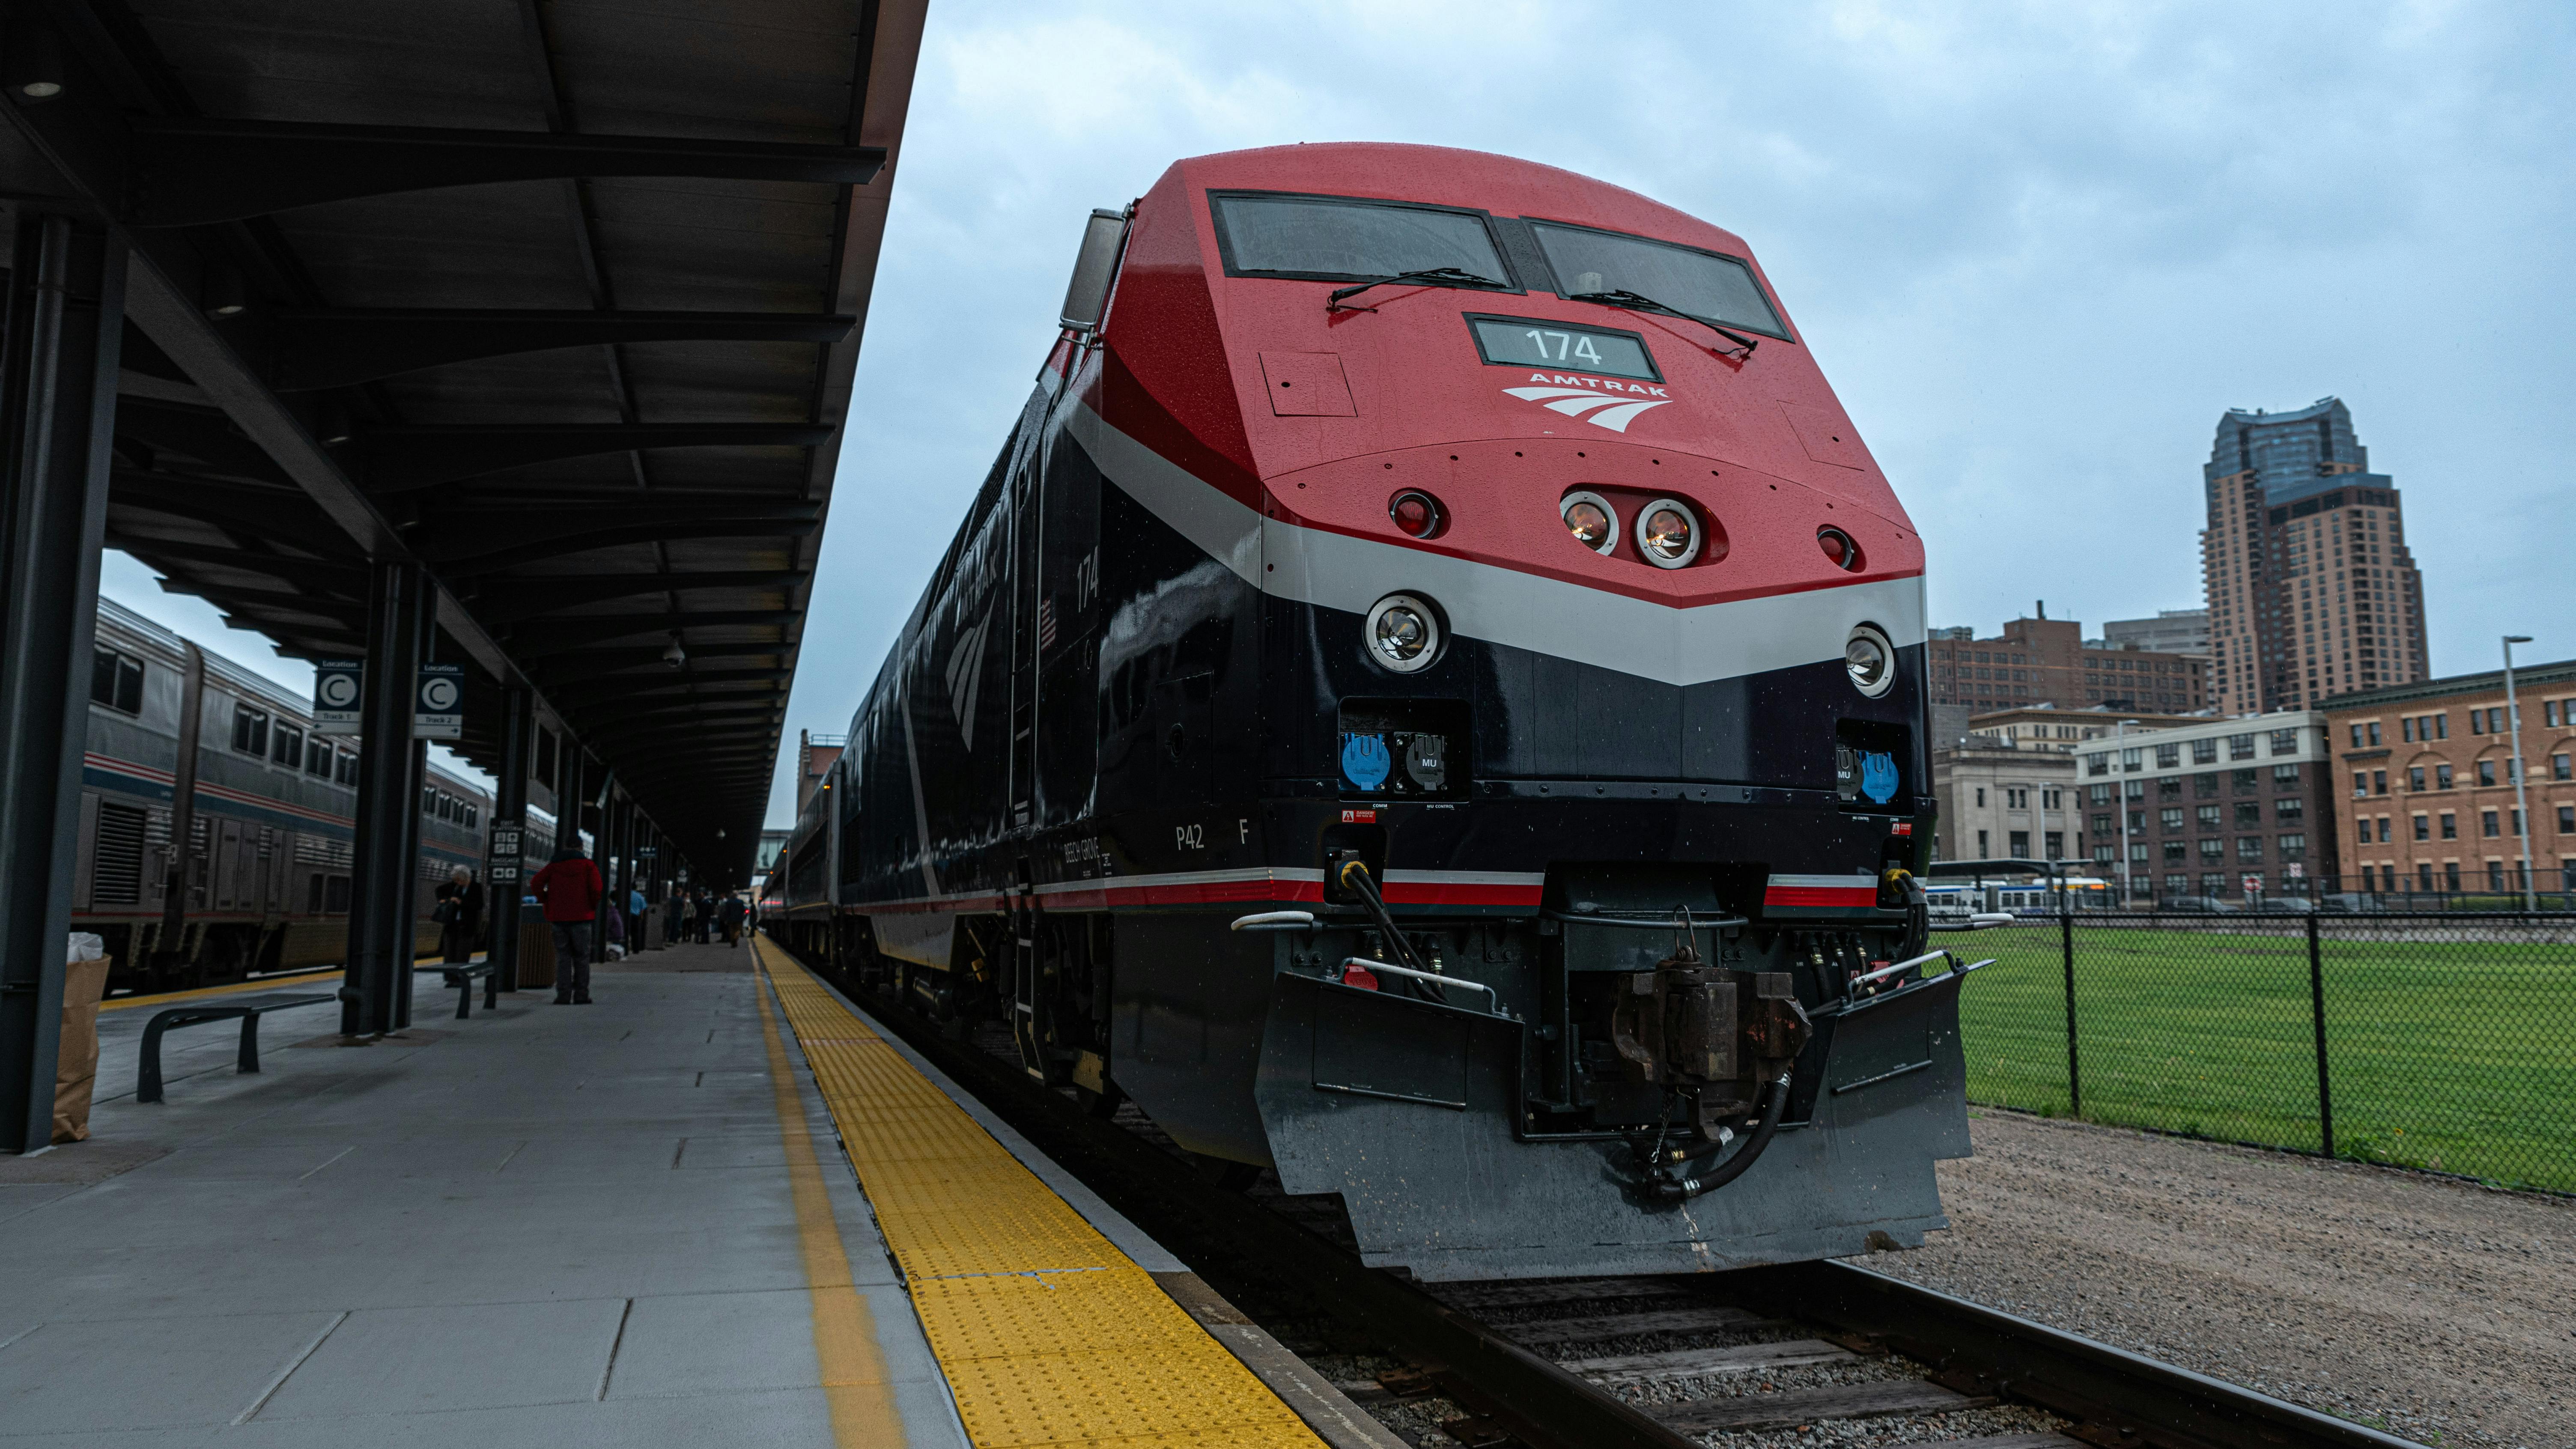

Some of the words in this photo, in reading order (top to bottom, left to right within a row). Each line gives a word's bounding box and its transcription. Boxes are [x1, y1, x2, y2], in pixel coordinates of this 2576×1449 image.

[1526, 330, 1601, 364] 174
[1530, 373, 1669, 398] AMTRAK
[1077, 545, 1098, 613] 174
[322, 660, 358, 668] Location
[328, 679, 345, 701] C
[429, 683, 447, 704] C
[1422, 759, 1437, 767] MU
[1176, 824, 1204, 850] P42
[1239, 819, 1248, 844] F
[1064, 841, 1082, 863] BEECH
[1081, 836, 1100, 861] GROVE
